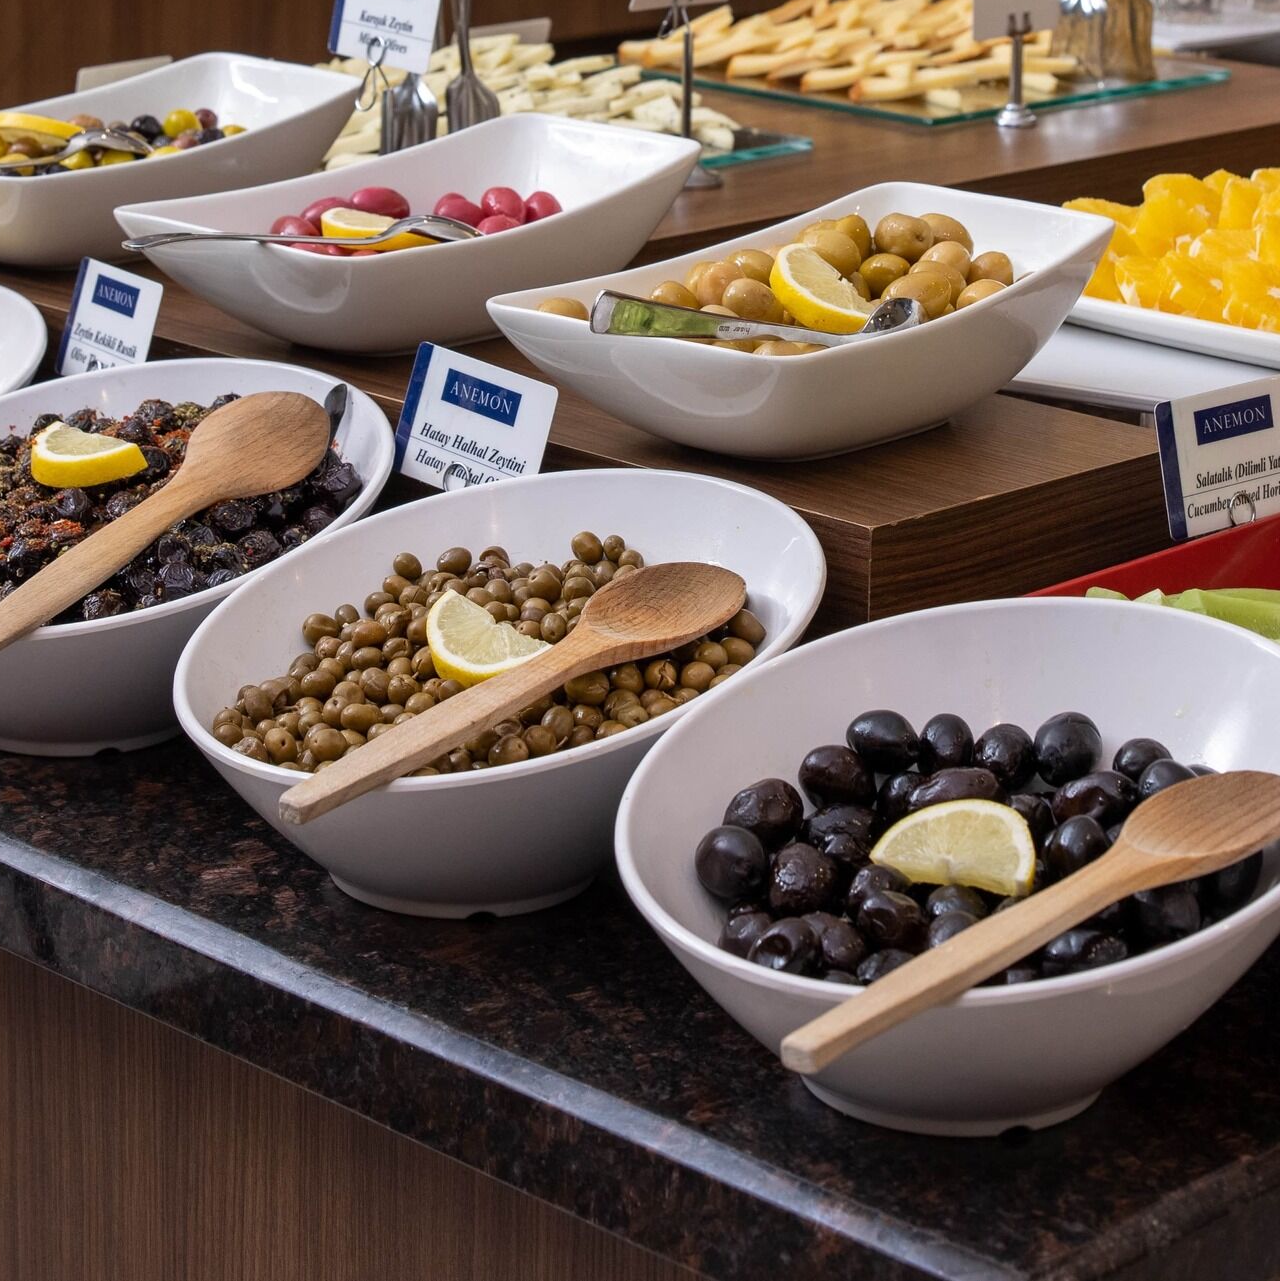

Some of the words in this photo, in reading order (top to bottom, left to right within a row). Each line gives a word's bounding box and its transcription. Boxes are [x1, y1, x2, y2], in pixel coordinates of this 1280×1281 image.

[97, 283, 135, 308] ANEMON
[74, 323, 93, 341] Zeytin
[450, 381, 513, 415] ANEMON
[1203, 405, 1266, 434] ANEMON
[415, 448, 446, 474] Hatay
[420, 422, 451, 448] Hatay
[451, 434, 489, 460] Halhal
[488, 448, 527, 474] Zeytini
[1196, 466, 1233, 489] Salatalık
[1234, 457, 1266, 481] (Dilimli
